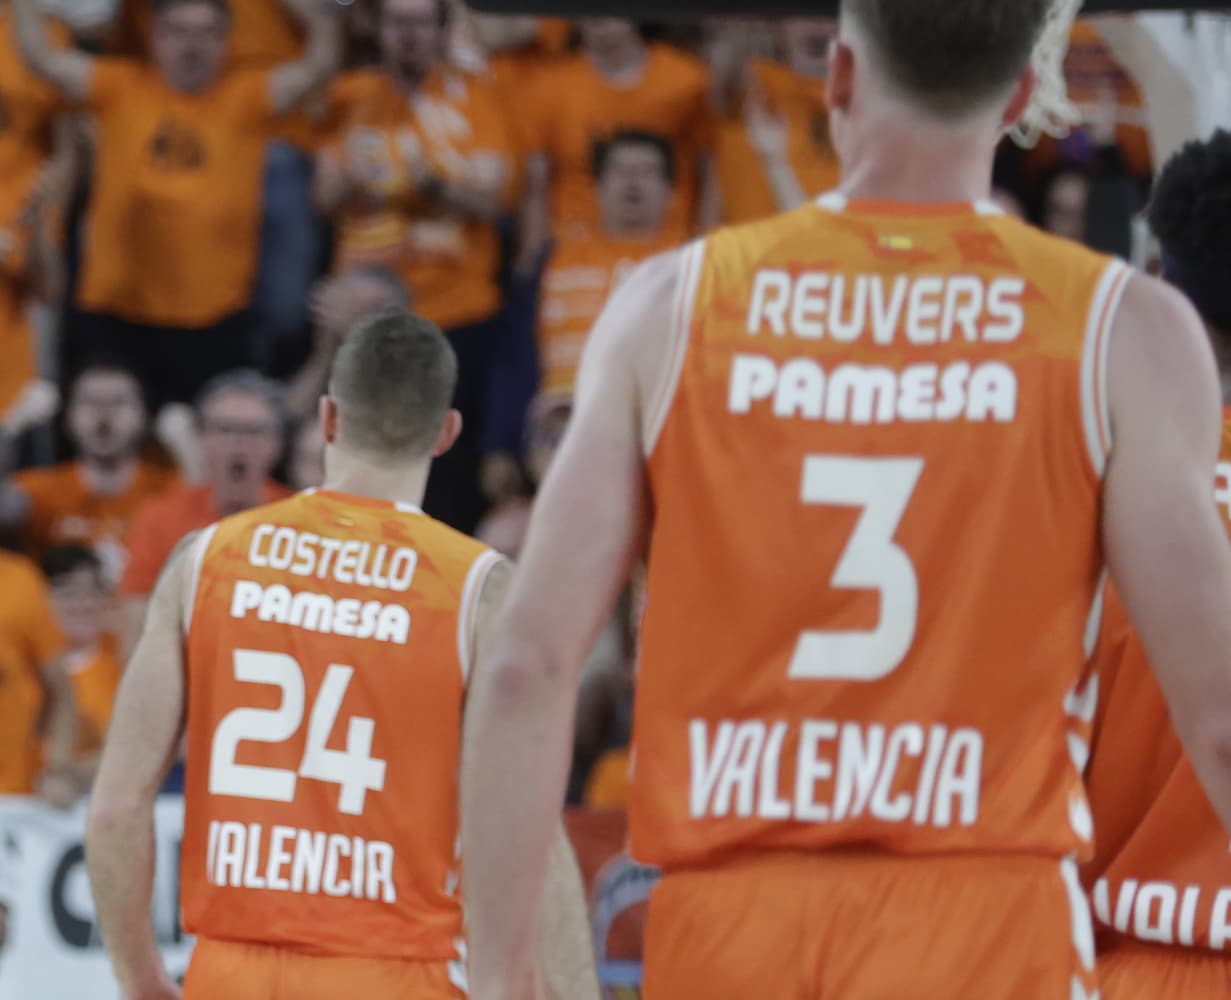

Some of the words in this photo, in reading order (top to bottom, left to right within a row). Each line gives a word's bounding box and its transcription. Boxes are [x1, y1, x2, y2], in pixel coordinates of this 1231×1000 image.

[746, 269, 1026, 345] REUVERS
[728, 353, 1018, 424] PAMESA
[248, 523, 419, 592] COSTELLO
[786, 453, 926, 682] 3
[230, 579, 411, 645] PAMESA
[208, 647, 388, 817] 24
[687, 717, 984, 827] VALENCIA
